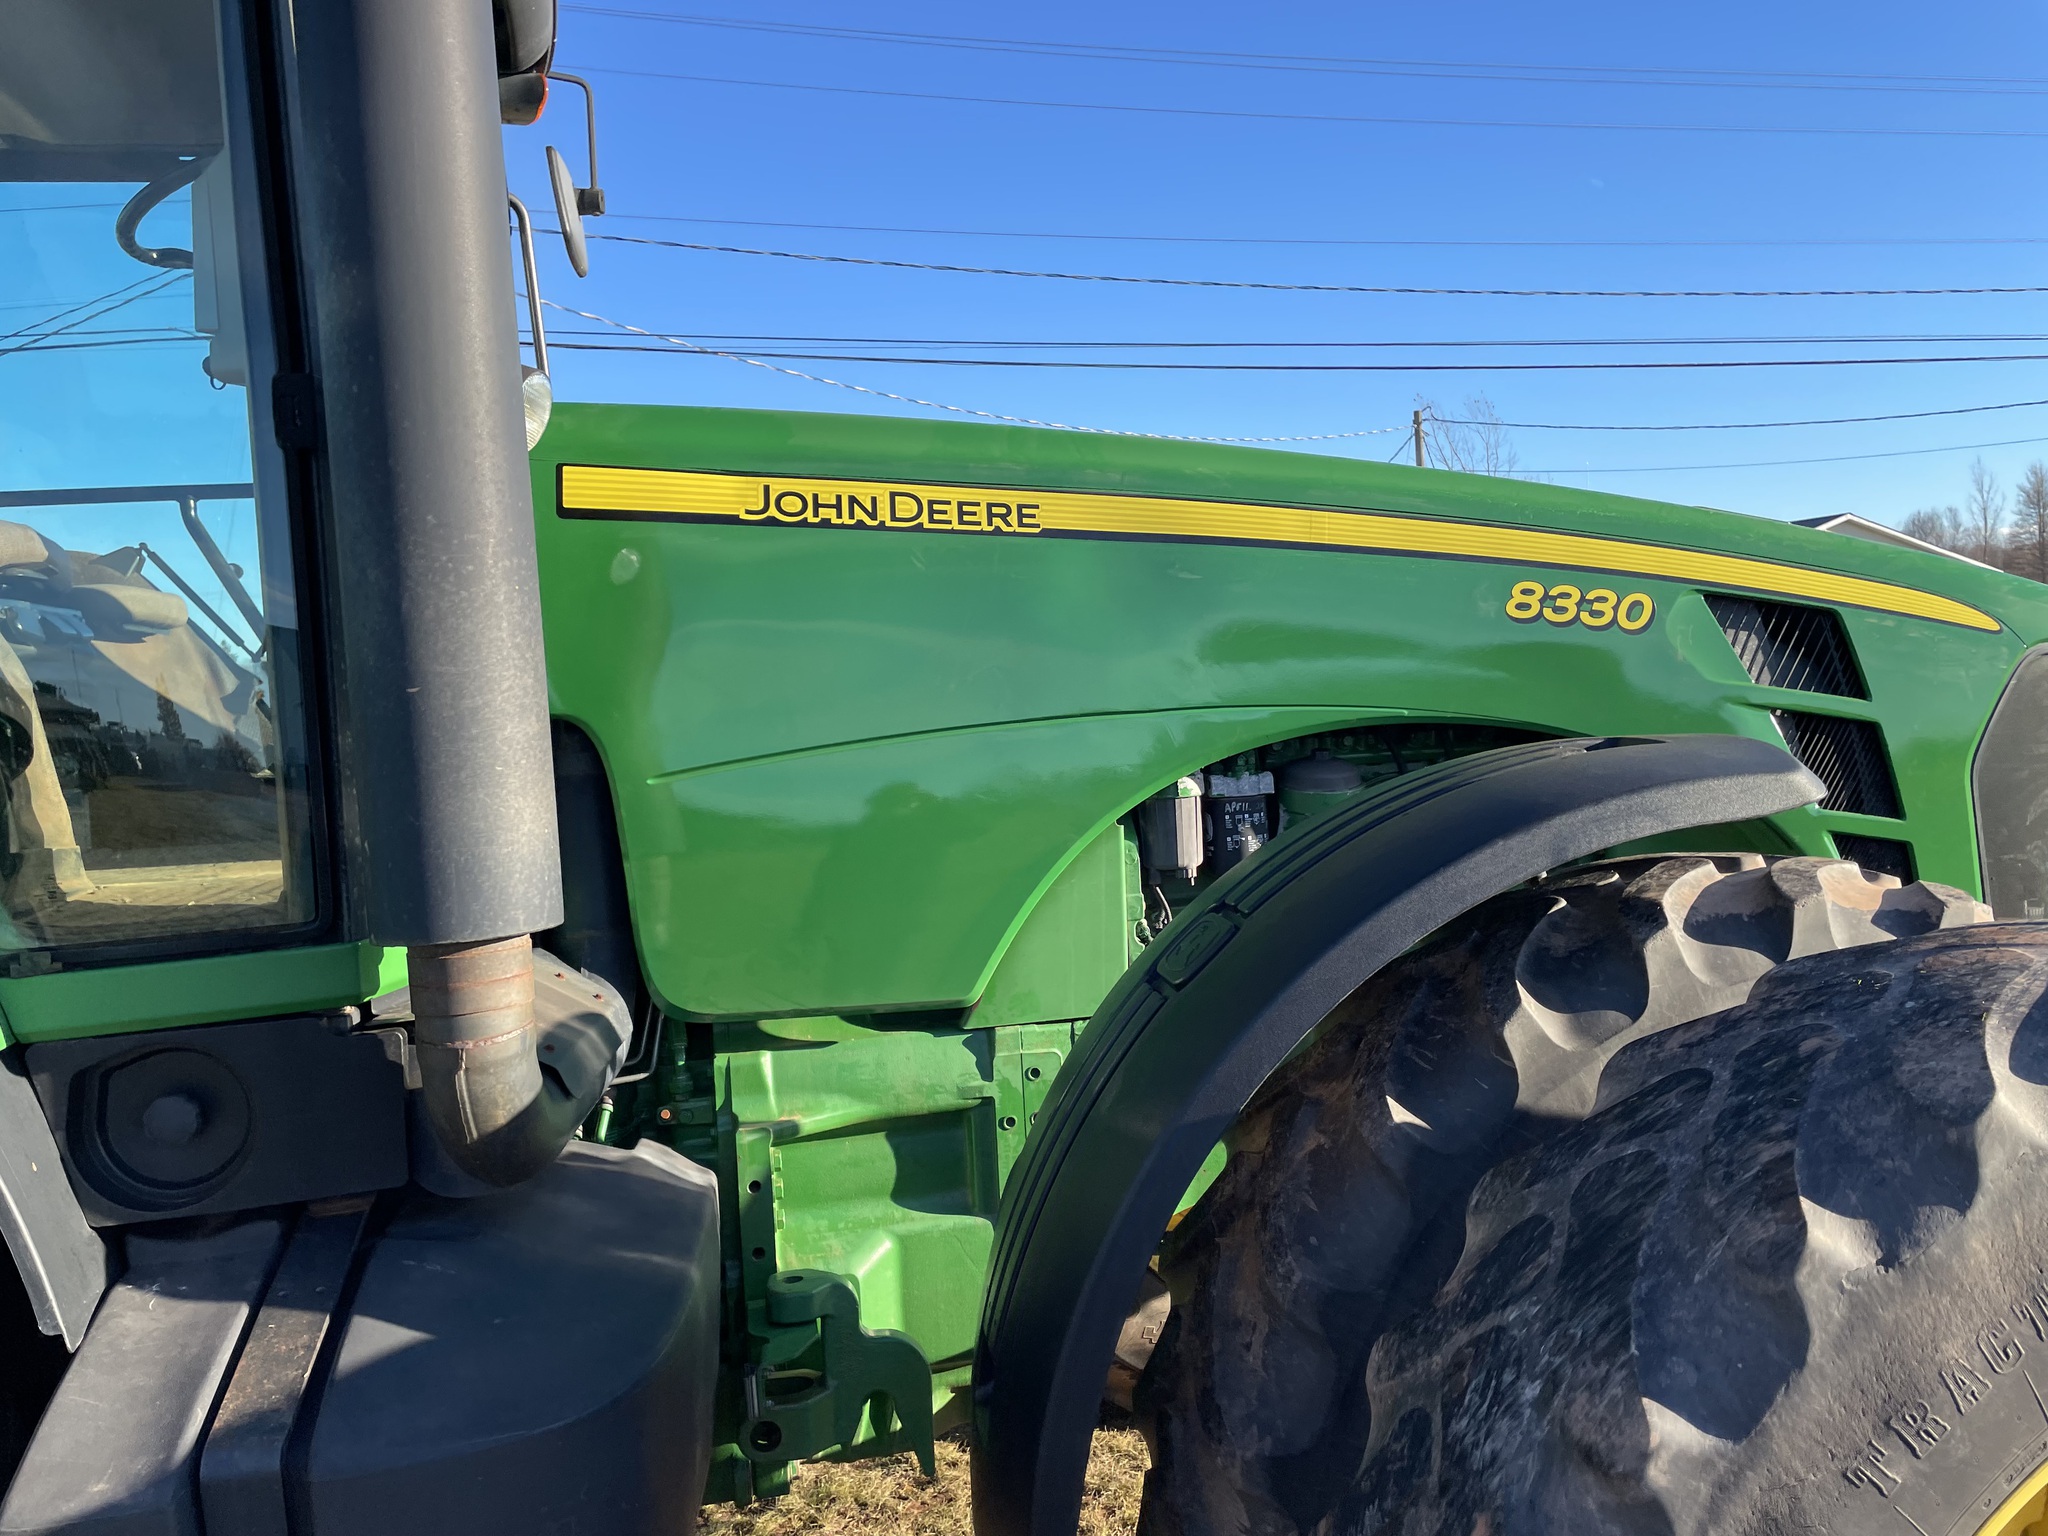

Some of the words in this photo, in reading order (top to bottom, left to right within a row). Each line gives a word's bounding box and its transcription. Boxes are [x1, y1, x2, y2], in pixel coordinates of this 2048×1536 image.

[743, 483, 880, 523] JOHN
[887, 490, 1043, 530] DEERE
[1505, 580, 1655, 633] 8330
